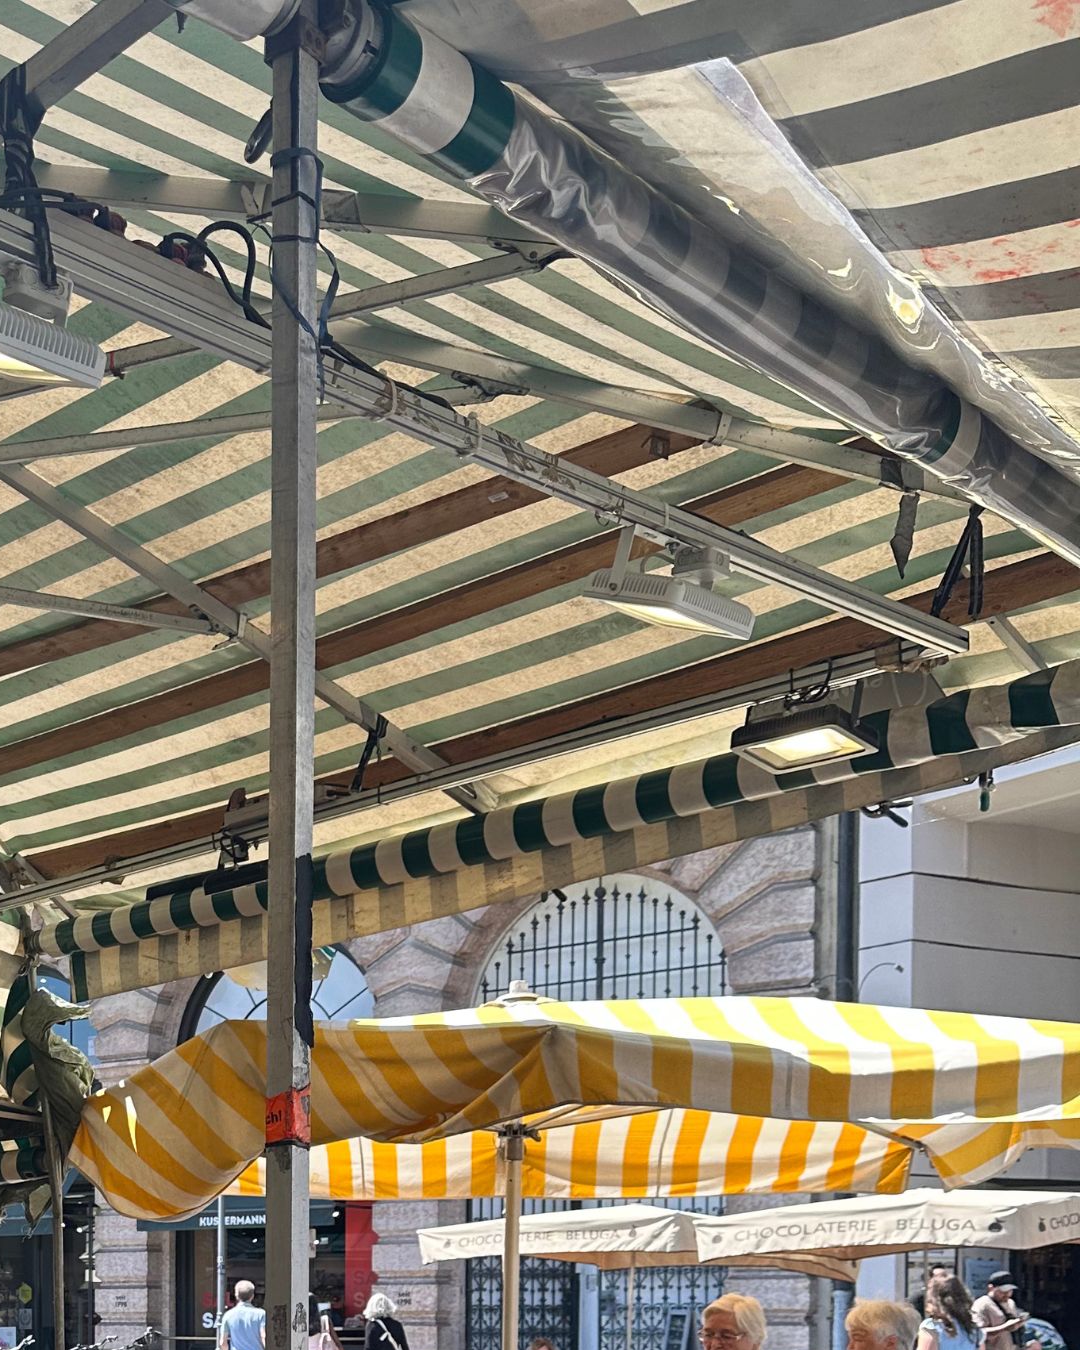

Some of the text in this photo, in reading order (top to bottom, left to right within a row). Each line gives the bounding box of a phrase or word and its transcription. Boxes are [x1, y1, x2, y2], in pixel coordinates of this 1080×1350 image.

[199, 1214, 266, 1227] KUSERMANN
[734, 1217, 977, 1243] CHOCOLATERIE BELUGA
[458, 1228, 621, 1248] CHOCOTERIE BELUGA
